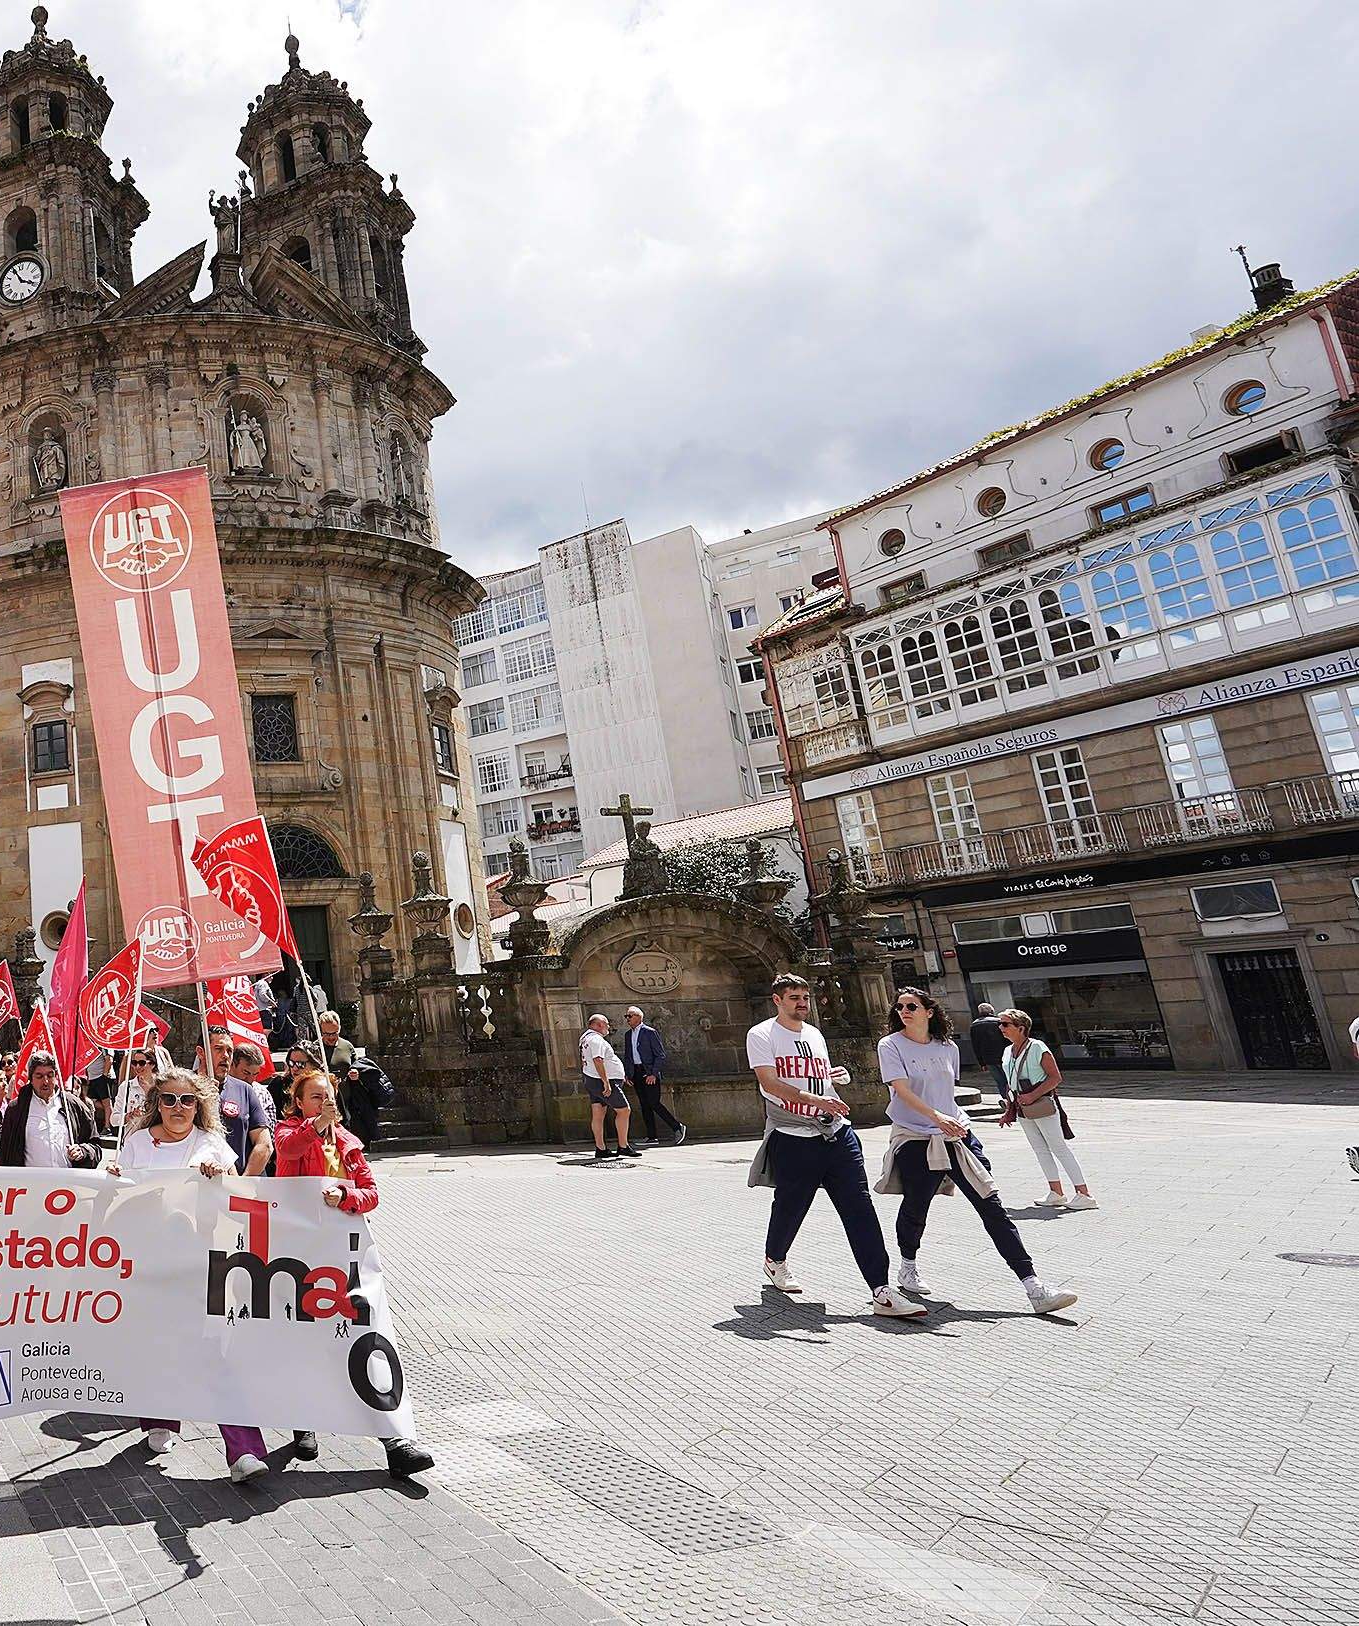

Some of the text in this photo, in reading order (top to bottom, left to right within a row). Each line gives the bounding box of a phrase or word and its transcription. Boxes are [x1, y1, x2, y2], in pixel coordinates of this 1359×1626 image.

[103, 503, 174, 554] UGT
[1199, 655, 1359, 705] Alianza Españ
[115, 589, 225, 898] UGT
[876, 727, 1059, 780] Alianza Española Seguros
[1003, 883, 1034, 892] VIAJES
[143, 915, 189, 941] UGT
[203, 917, 246, 934] Galicia
[204, 931, 247, 943] PONTEVEDRA
[1017, 941, 1068, 957] Orange
[44, 1188, 77, 1217] o
[21, 1342, 72, 1358] Galicia
[21, 1366, 107, 1384] Pontevedra,
[21, 1386, 125, 1404] Arousa e Deza
